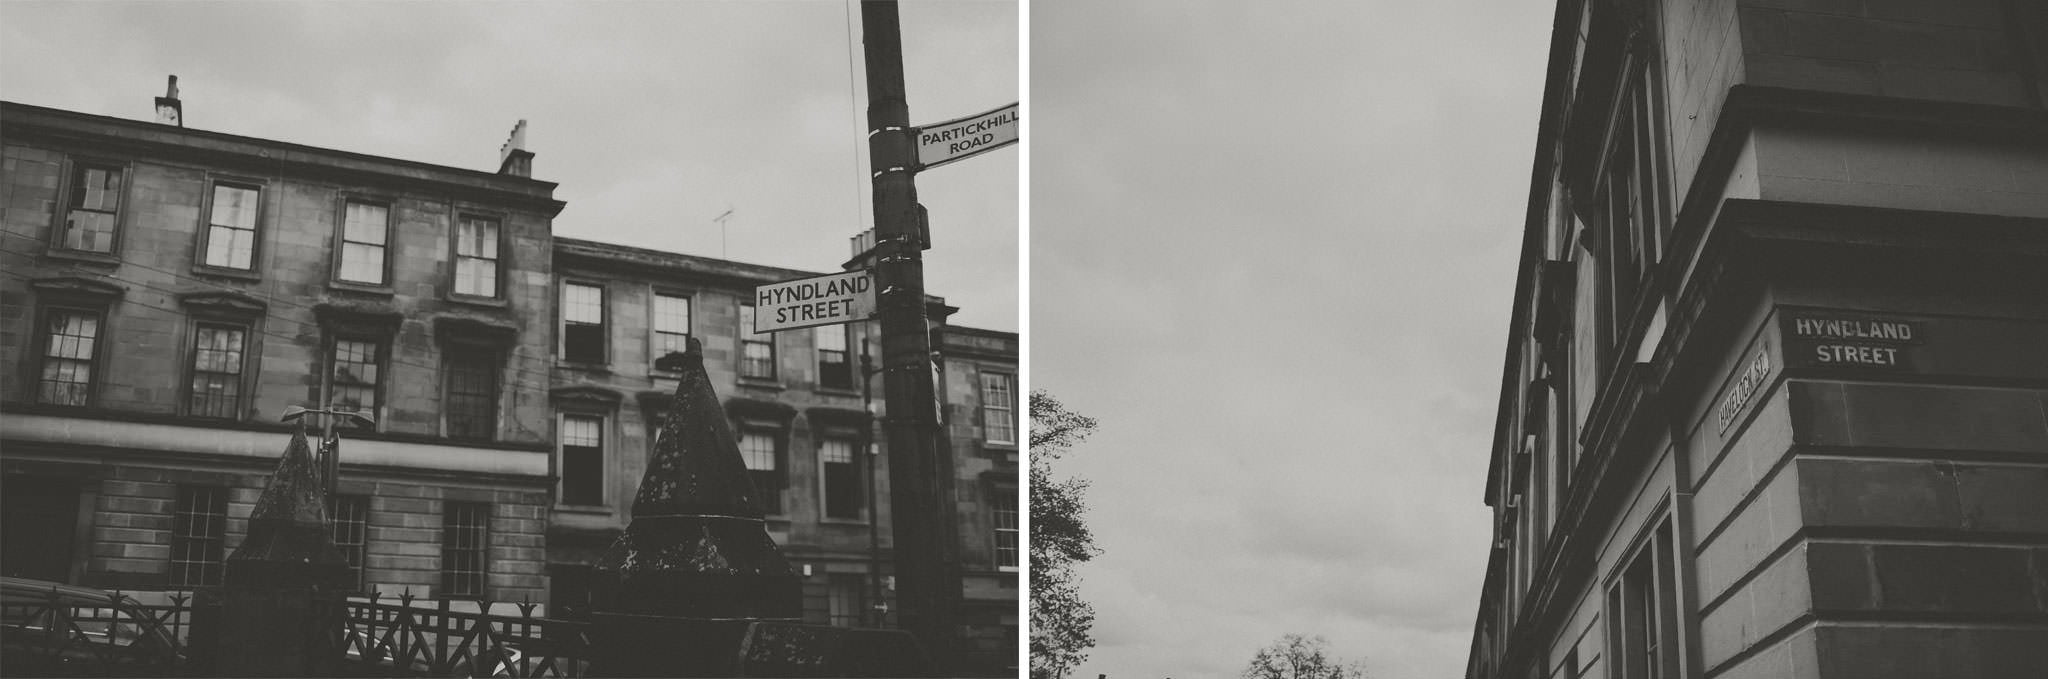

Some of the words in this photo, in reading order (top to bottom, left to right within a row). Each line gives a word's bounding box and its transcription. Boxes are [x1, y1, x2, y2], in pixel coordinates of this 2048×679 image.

[922, 111, 1019, 146] PARTICKHILL
[949, 133, 994, 154] ROAD
[759, 275, 870, 306] HYNDLAND
[776, 298, 854, 323] STREET
[1796, 318, 1912, 340] HYNDLAND
[1816, 345, 1897, 365] STREET
[1719, 367, 1753, 431] HAVELOCK
